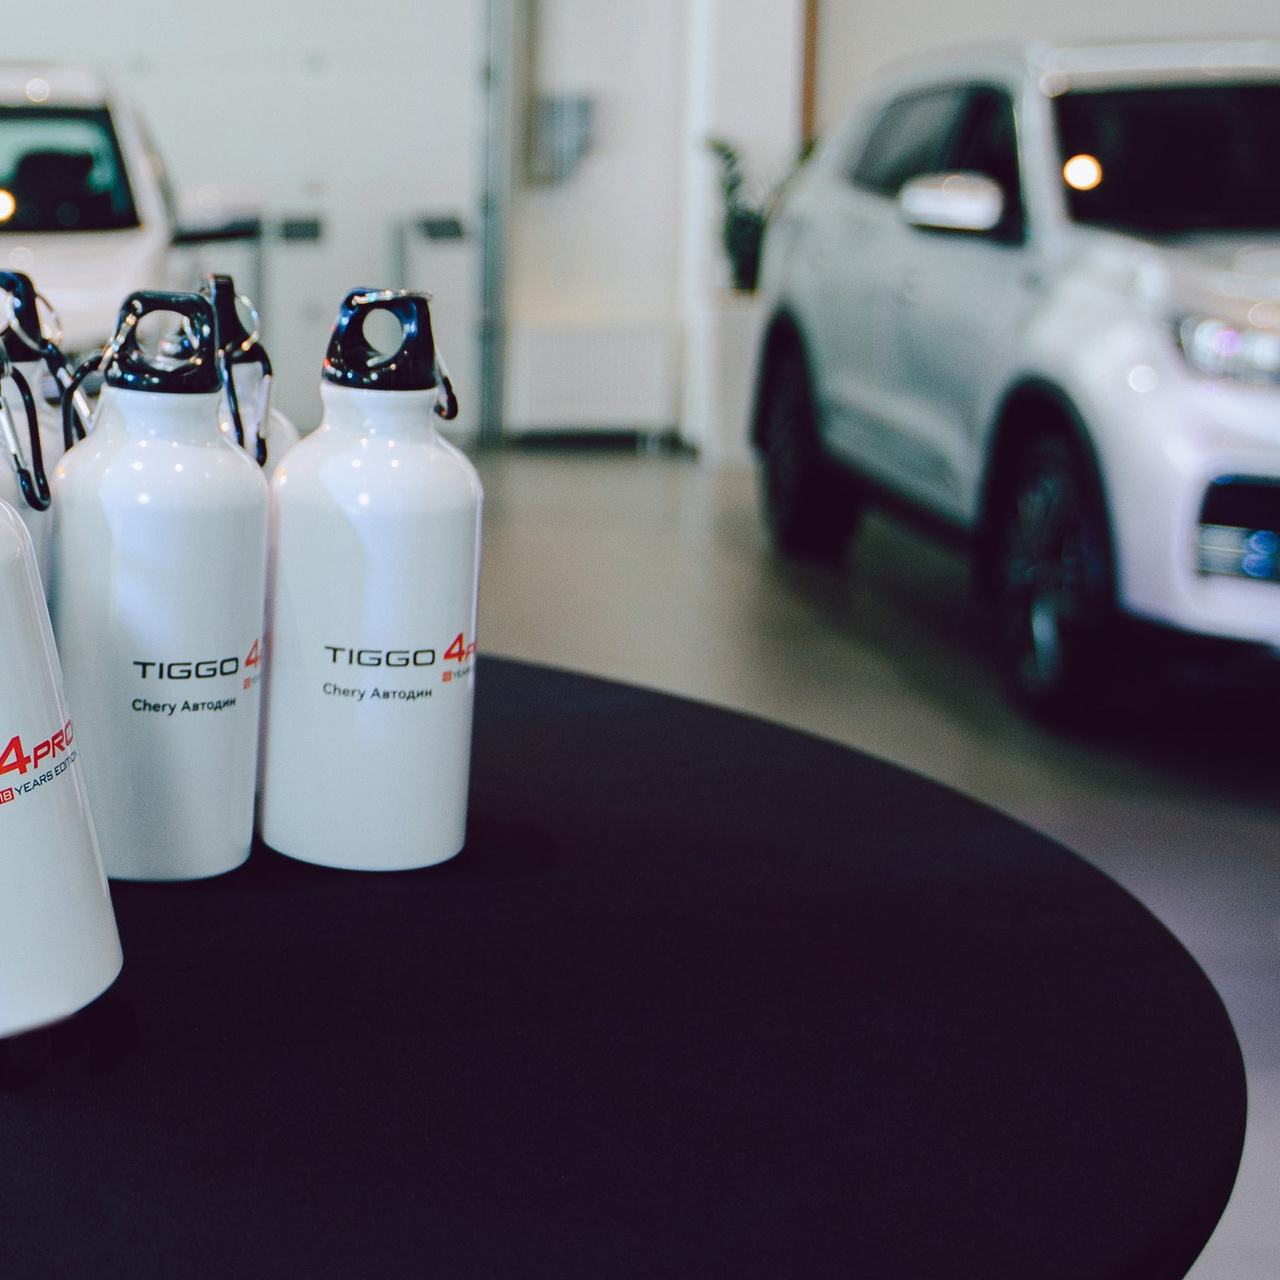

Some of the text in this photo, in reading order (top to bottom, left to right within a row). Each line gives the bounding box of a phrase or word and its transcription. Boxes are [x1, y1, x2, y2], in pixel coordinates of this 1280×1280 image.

[324, 645, 436, 667] TIGGO
[132, 656, 239, 680] TIGGO
[322, 682, 433, 701] Chery Автодин
[131, 696, 236, 716] Chery Автодин
[14, 771, 54, 796] YEARS
